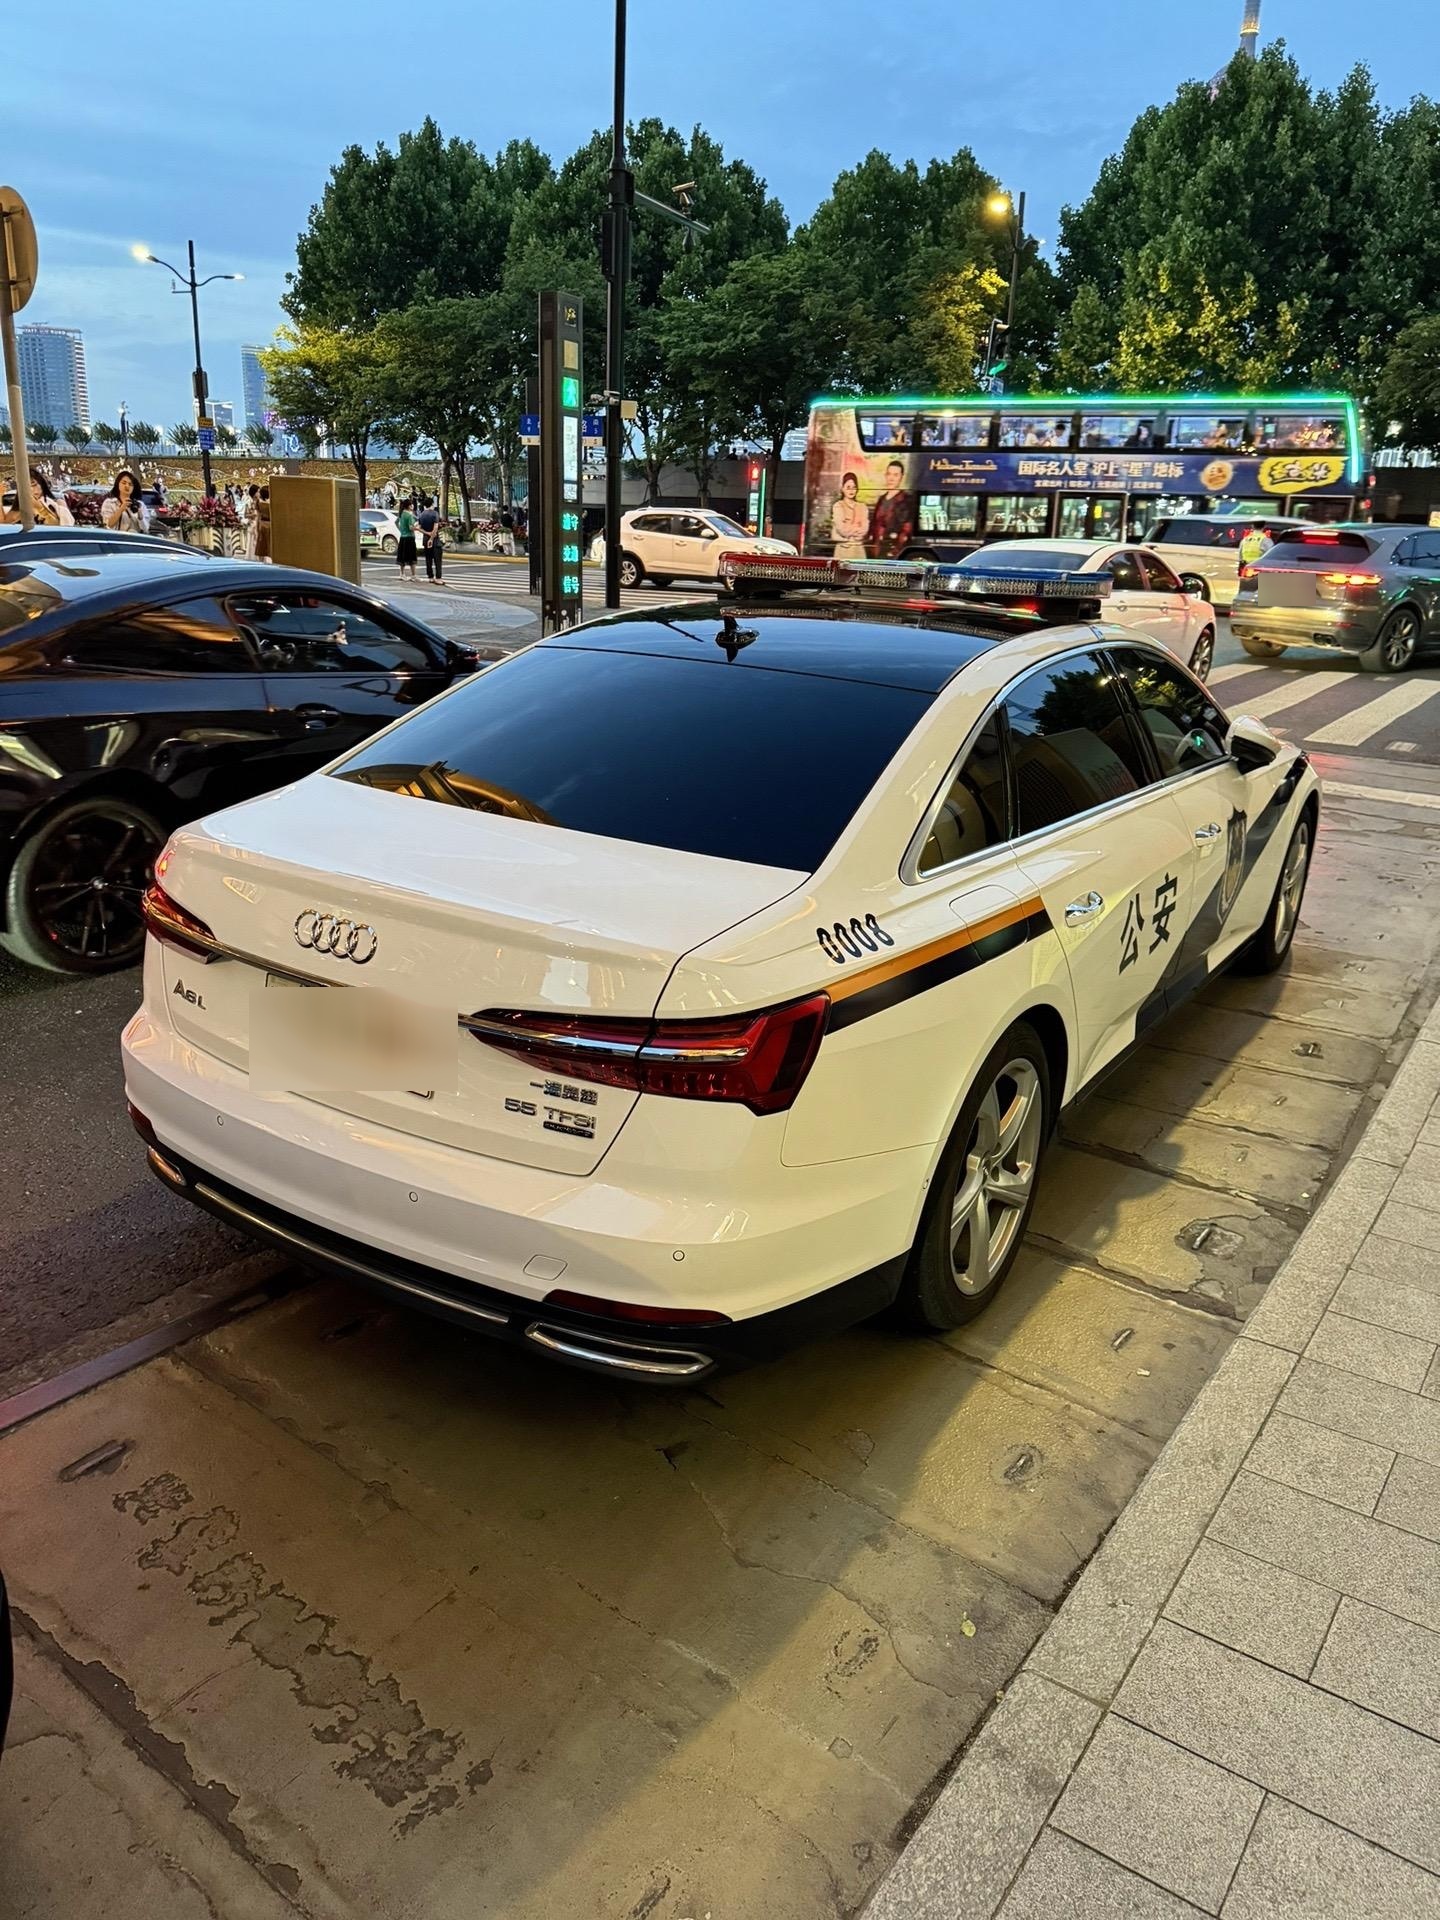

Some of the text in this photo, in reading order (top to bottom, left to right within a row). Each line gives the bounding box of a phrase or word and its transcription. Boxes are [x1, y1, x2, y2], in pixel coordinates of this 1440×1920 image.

[1017, 460, 1089, 477] 国际名人堂
[562, 575, 580, 594] 信号
[1119, 872, 1178, 975] 公安
[816, 913, 895, 964] 0008
[172, 978, 207, 1011] A6L
[505, 1098, 537, 1116] 55
